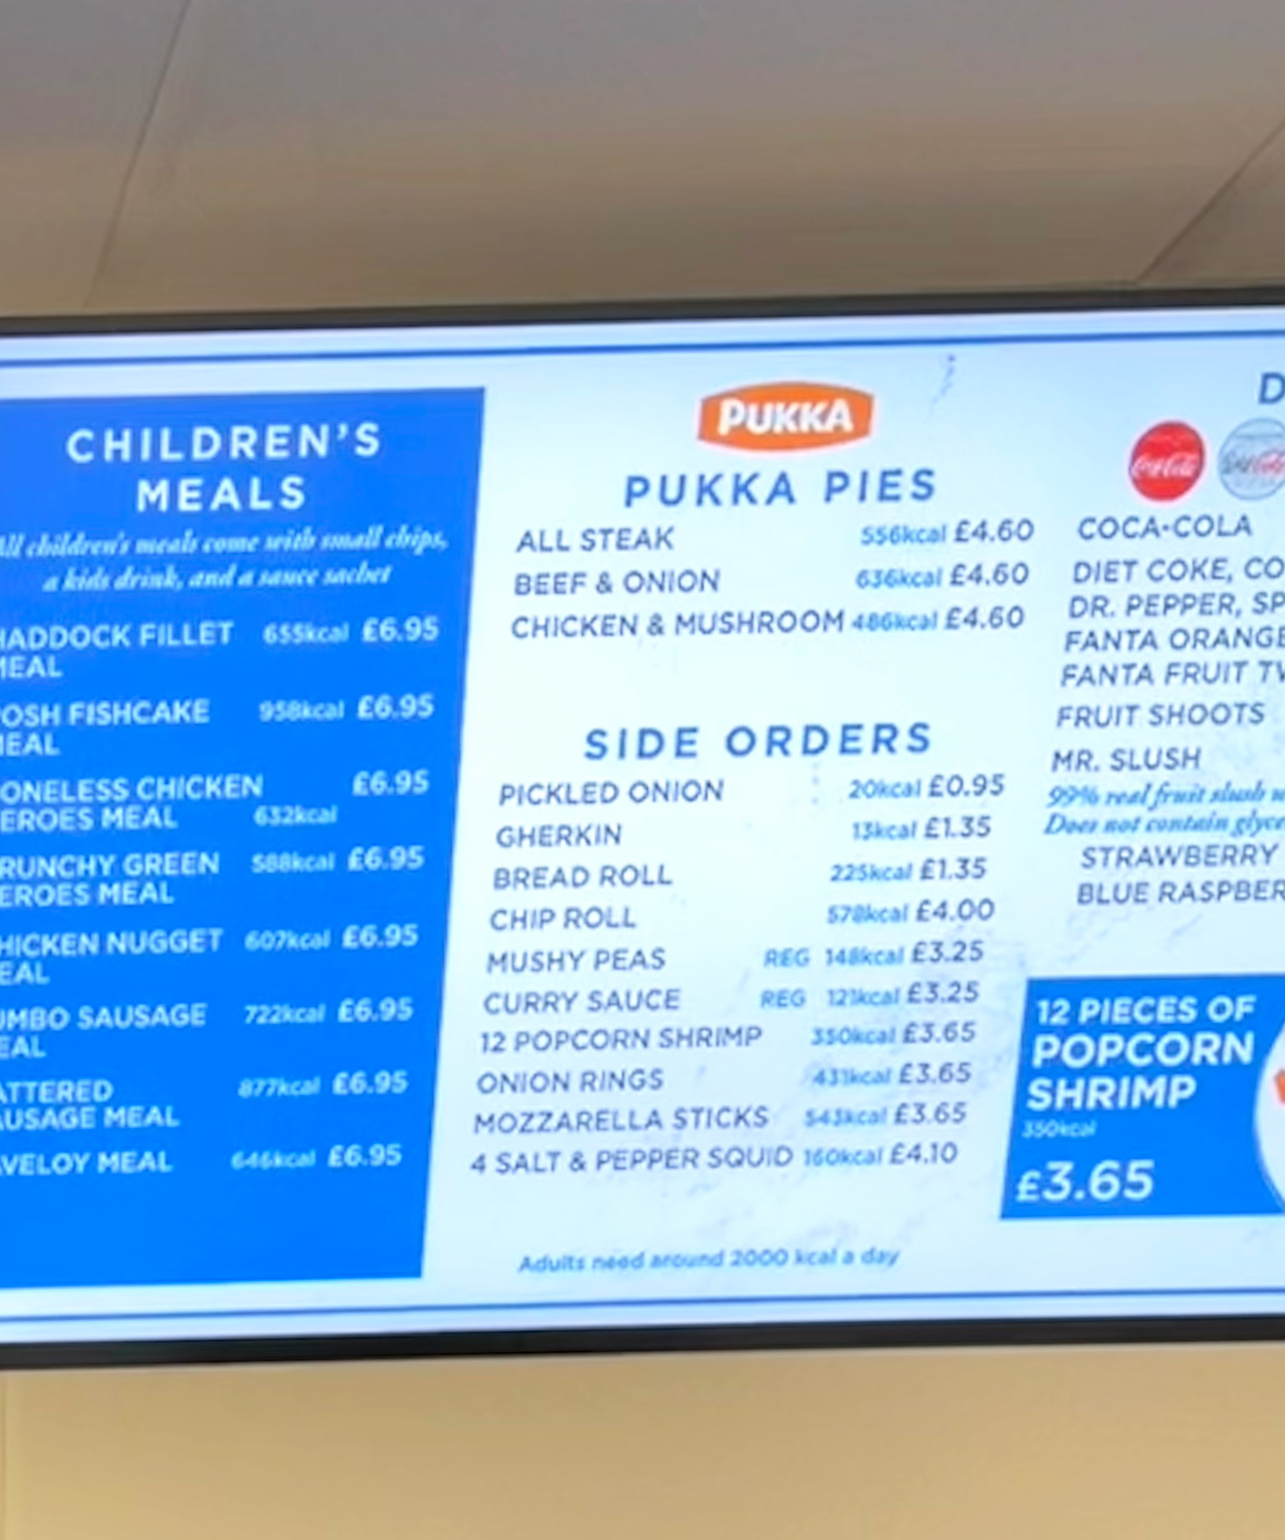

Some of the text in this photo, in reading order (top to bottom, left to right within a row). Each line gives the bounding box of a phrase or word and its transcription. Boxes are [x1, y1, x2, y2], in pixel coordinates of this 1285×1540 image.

[718, 398, 853, 435] PUKKA
[67, 422, 379, 463] CHILDREN'S
[137, 476, 304, 512] MEALS
[625, 468, 934, 508] PUKKA PIES
[516, 518, 1034, 552] ALL STEAK 556kcal £4.60
[1073, 557, 1233, 584] DIET COKE,
[140, 621, 234, 646] FILLET
[363, 616, 438, 642] £6.95
[1057, 702, 1265, 728] FRUIT SHOOTS
[585, 722, 930, 760] SIDE ORDERS
[499, 774, 1004, 806] PICKLED ONION 20kcal £0.95
[1038, 995, 1256, 1025] 12 PIECES OF
[1033, 1031, 1254, 1068] POPCORN
[1027, 1075, 1196, 1111] SHRIMP
[98, 1151, 173, 1173] MEAL
[328, 1143, 402, 1167] £6.95
[1017, 1160, 1154, 1201] £3.65
[518, 1247, 900, 1273] Adults need around 2000 kcal a day
